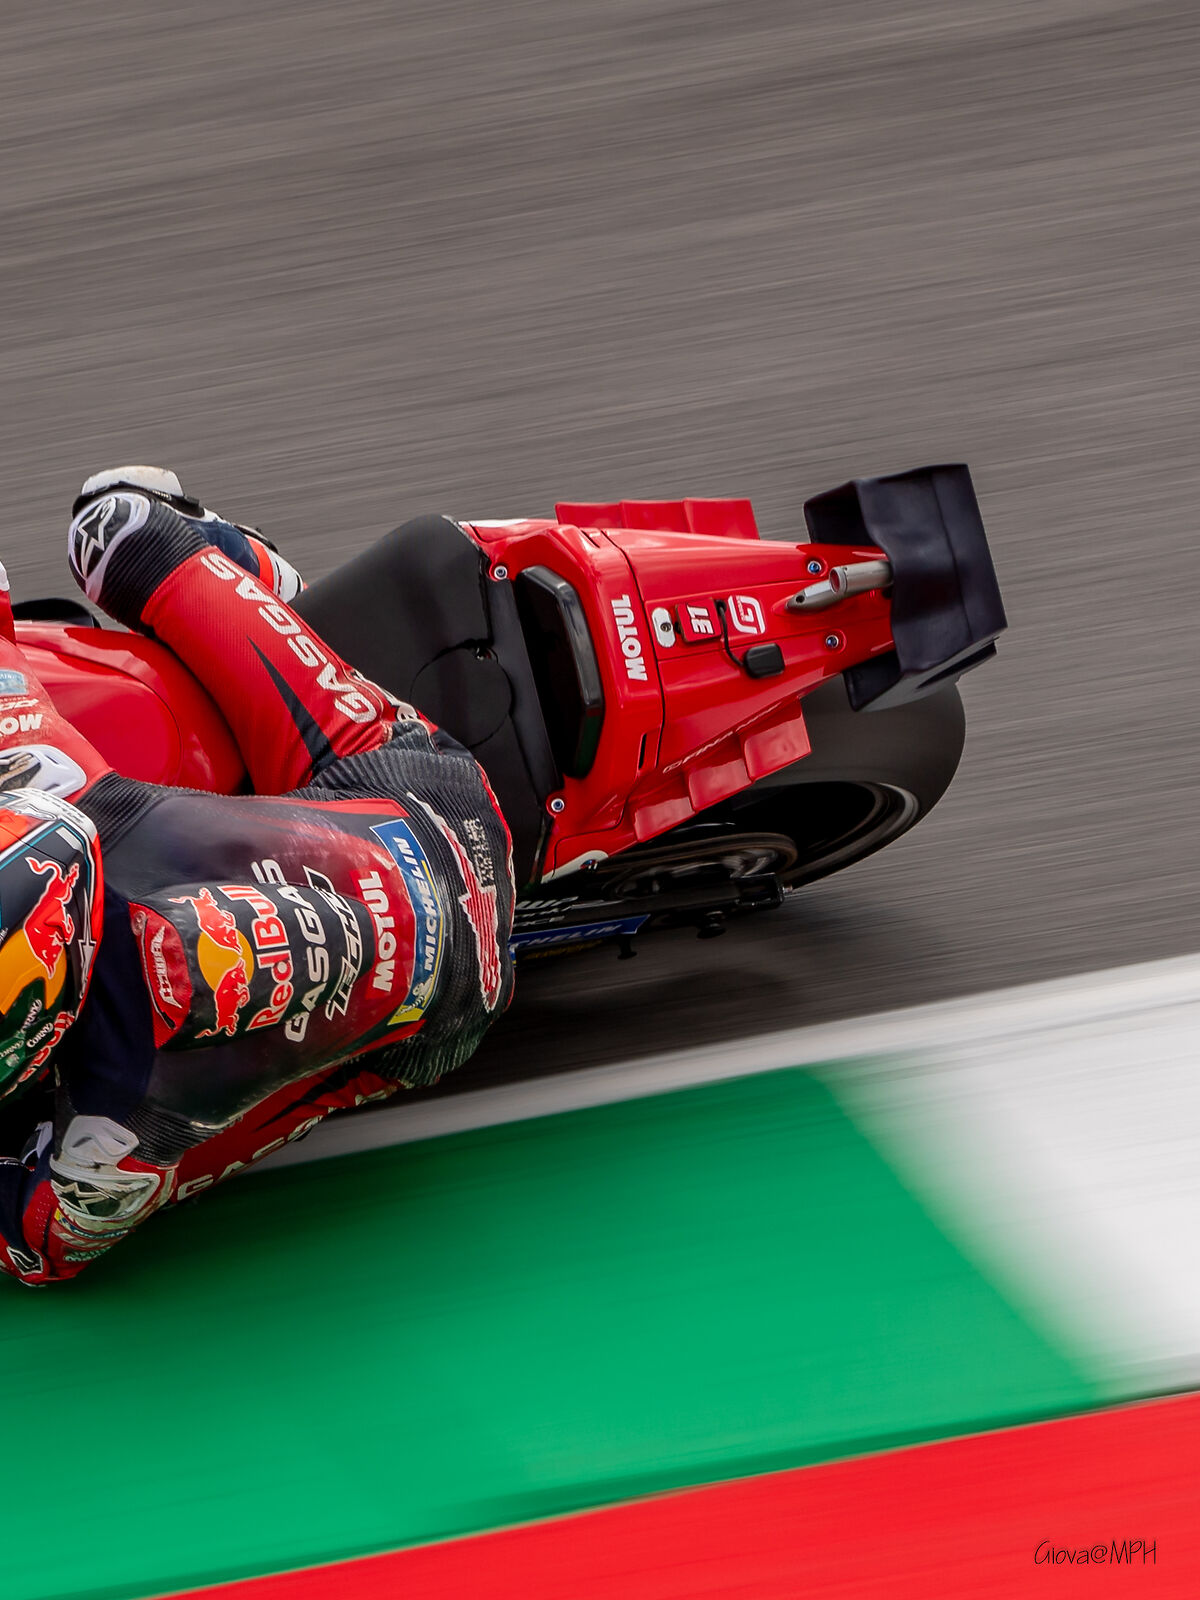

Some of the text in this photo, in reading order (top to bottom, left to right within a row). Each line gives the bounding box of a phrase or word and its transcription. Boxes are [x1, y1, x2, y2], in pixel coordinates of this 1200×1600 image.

[201, 553, 378, 724] GASGAS
[611, 594, 648, 681] MOTUL
[686, 604, 714, 635] 31
[250, 859, 331, 1042] GASGAS
[358, 871, 397, 992] MOTUL
[393, 837, 437, 972] MICHELIN
[27, 1022, 54, 1048] CORNY
